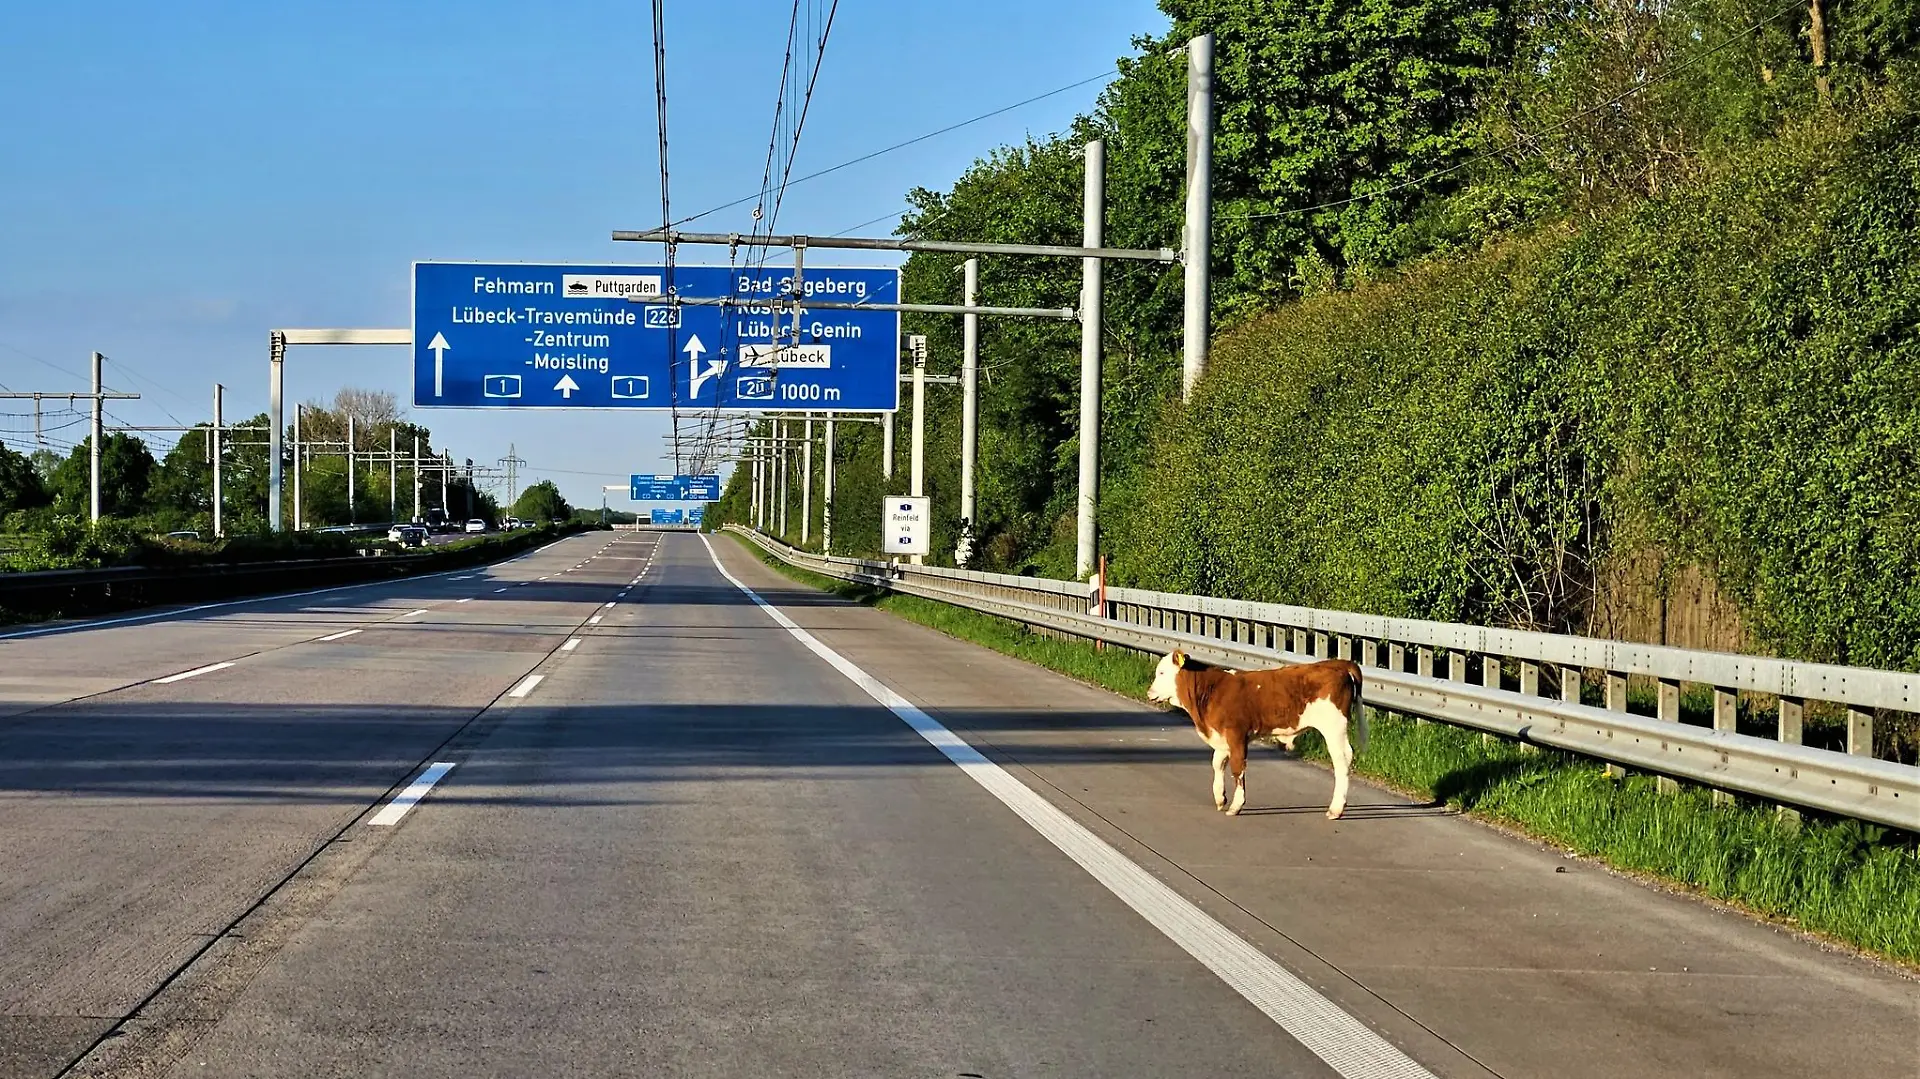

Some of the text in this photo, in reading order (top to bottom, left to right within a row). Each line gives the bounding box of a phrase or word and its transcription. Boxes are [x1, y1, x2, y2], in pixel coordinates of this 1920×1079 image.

[474, 277, 554, 294] Fehmarn
[595, 280, 656, 296] Puttgarden
[738, 276, 866, 298] Bad Sgeberg
[452, 306, 636, 325] Lübeck-Travemünde
[649, 311, 676, 325] 226
[737, 320, 862, 338] Lübc-Genin
[524, 330, 610, 348] -Zentrum
[524, 352, 609, 374] -Moisling
[776, 350, 825, 363] übeck
[499, 379, 506, 393] 1
[627, 380, 634, 394] 1
[780, 383, 841, 401] 1000 m
[892, 513, 919, 522] Reinfeld
[900, 524, 911, 532] via
